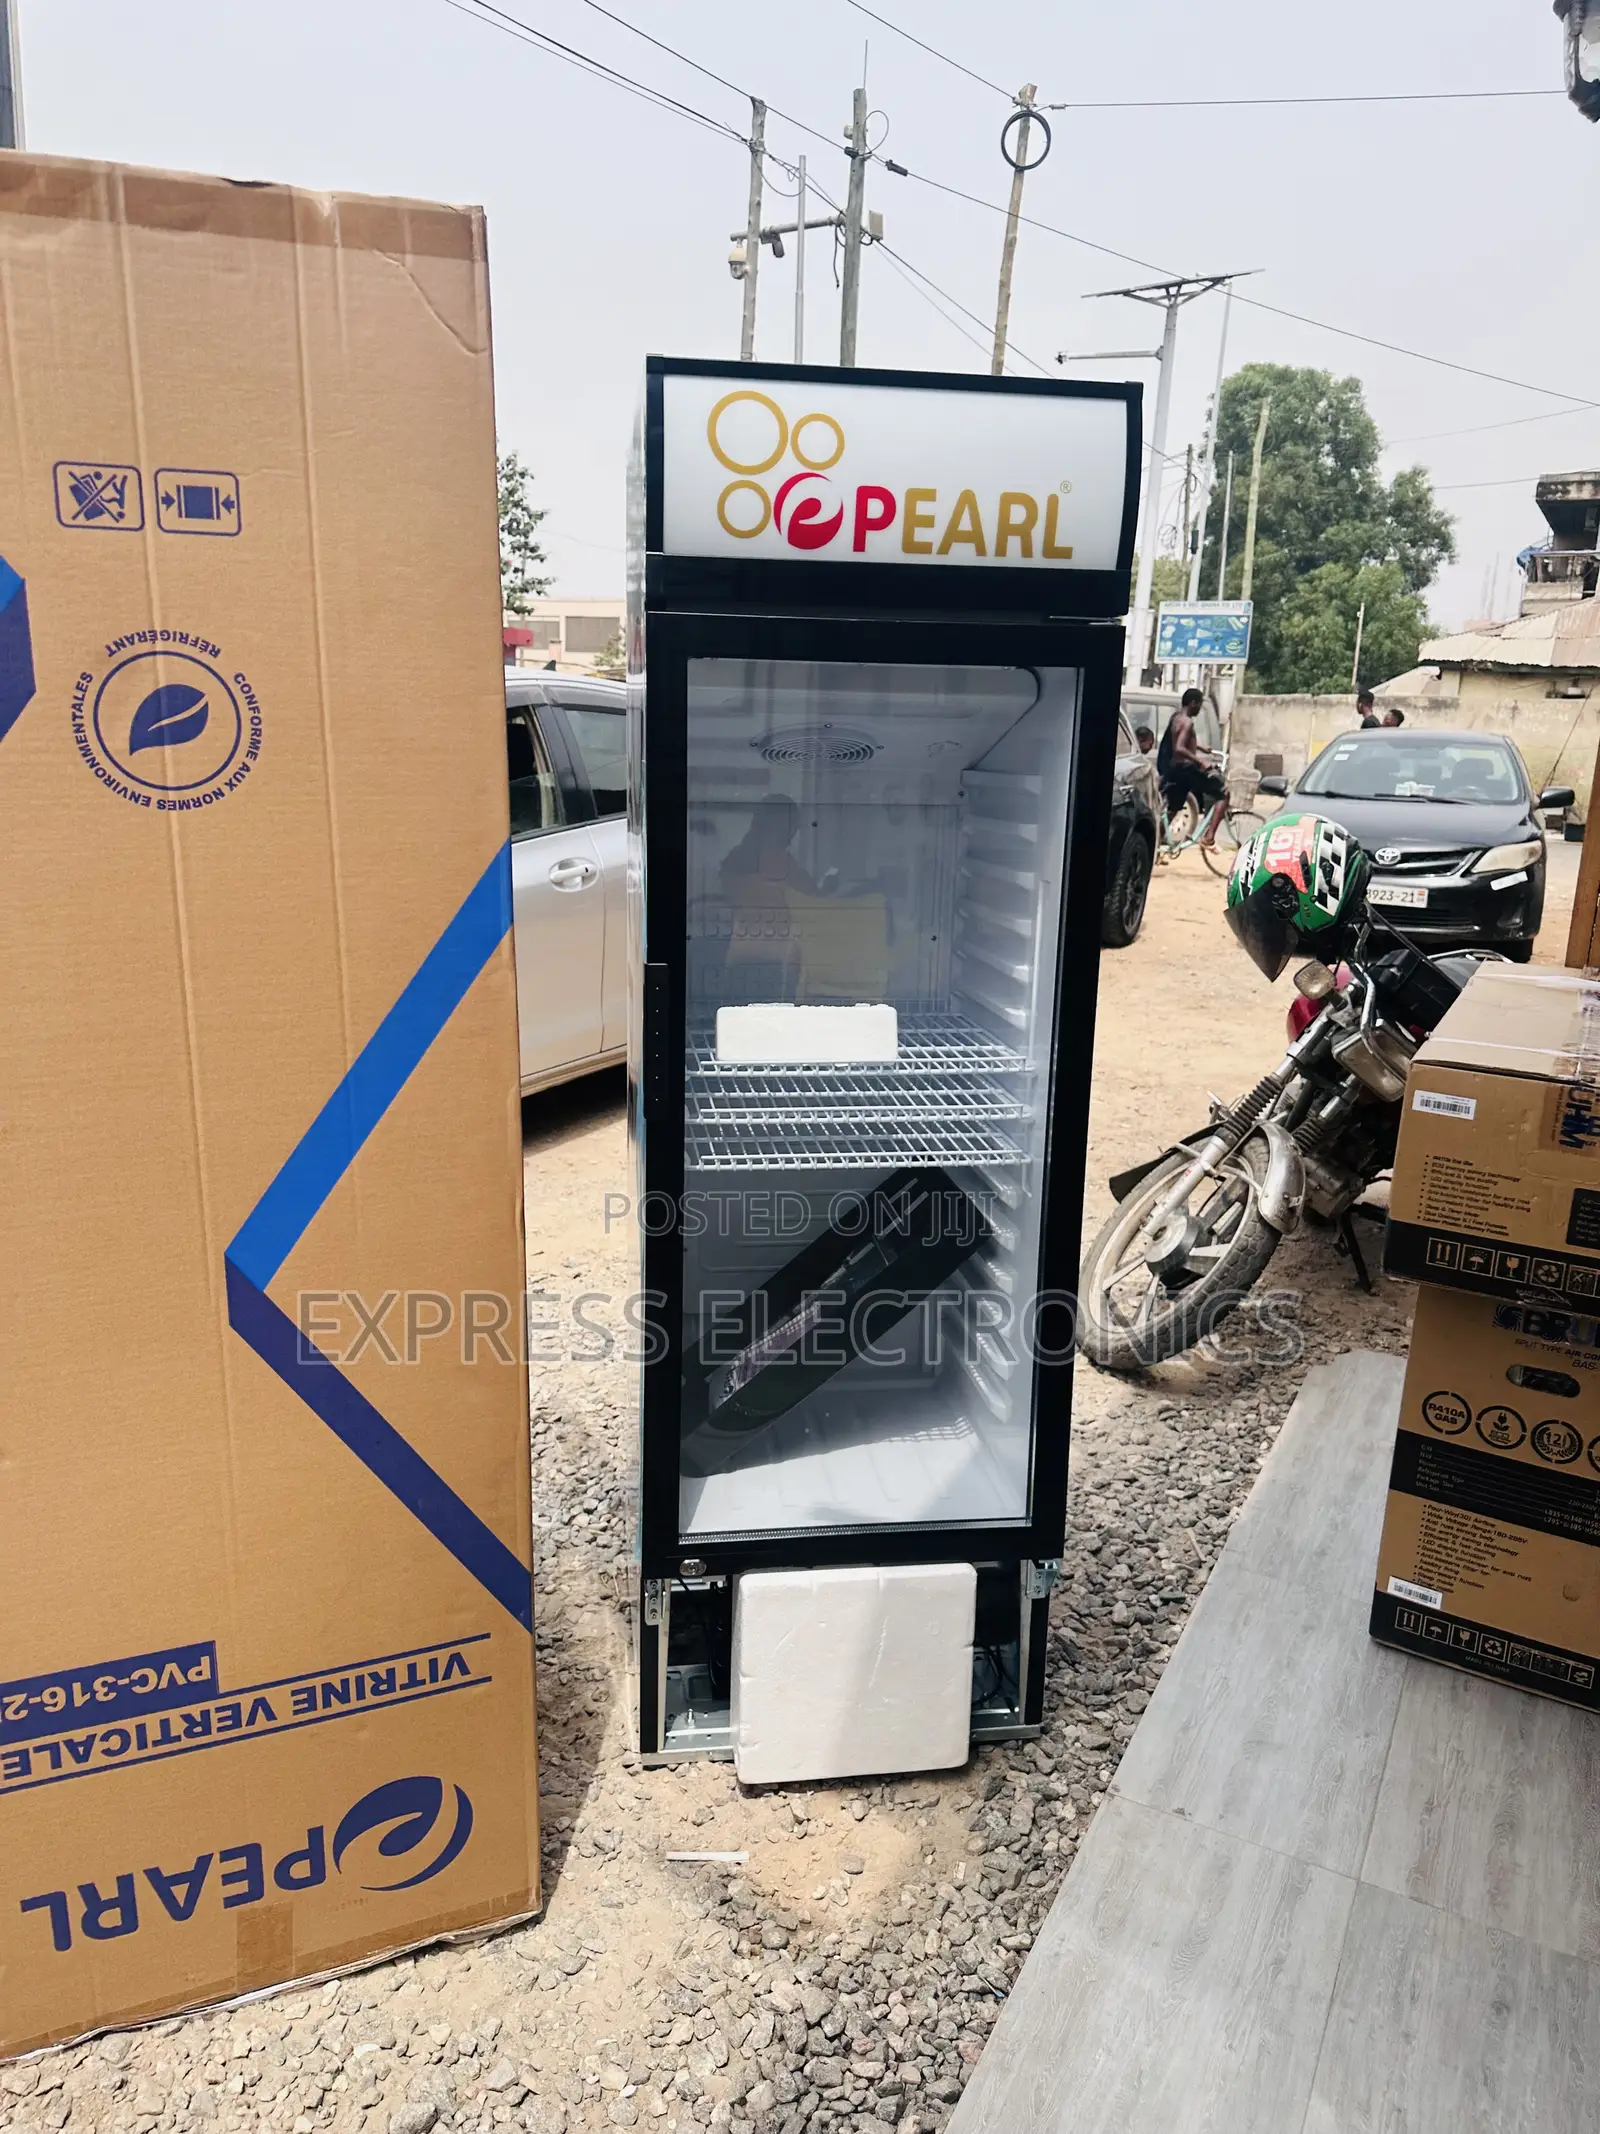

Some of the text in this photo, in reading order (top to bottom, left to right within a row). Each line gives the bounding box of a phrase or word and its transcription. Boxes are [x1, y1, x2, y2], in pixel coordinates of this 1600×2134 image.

[853, 486, 1073, 559] PEARL
[105, 629, 221, 658] RÉFRIGÉRANT
[72, 672, 262, 811] CONFORME AUX NORMES ENVIRONMENTALES
[1564, 1348, 1582, 1357] AIR
[1428, 1402, 1465, 1419] R410A
[1434, 1413, 1458, 1425] GAS
[0, 1655, 211, 1722] PVC-316-2
[0, 1650, 472, 1779] VITRINE VERTICALE
[20, 1824, 328, 1952] PEARL
